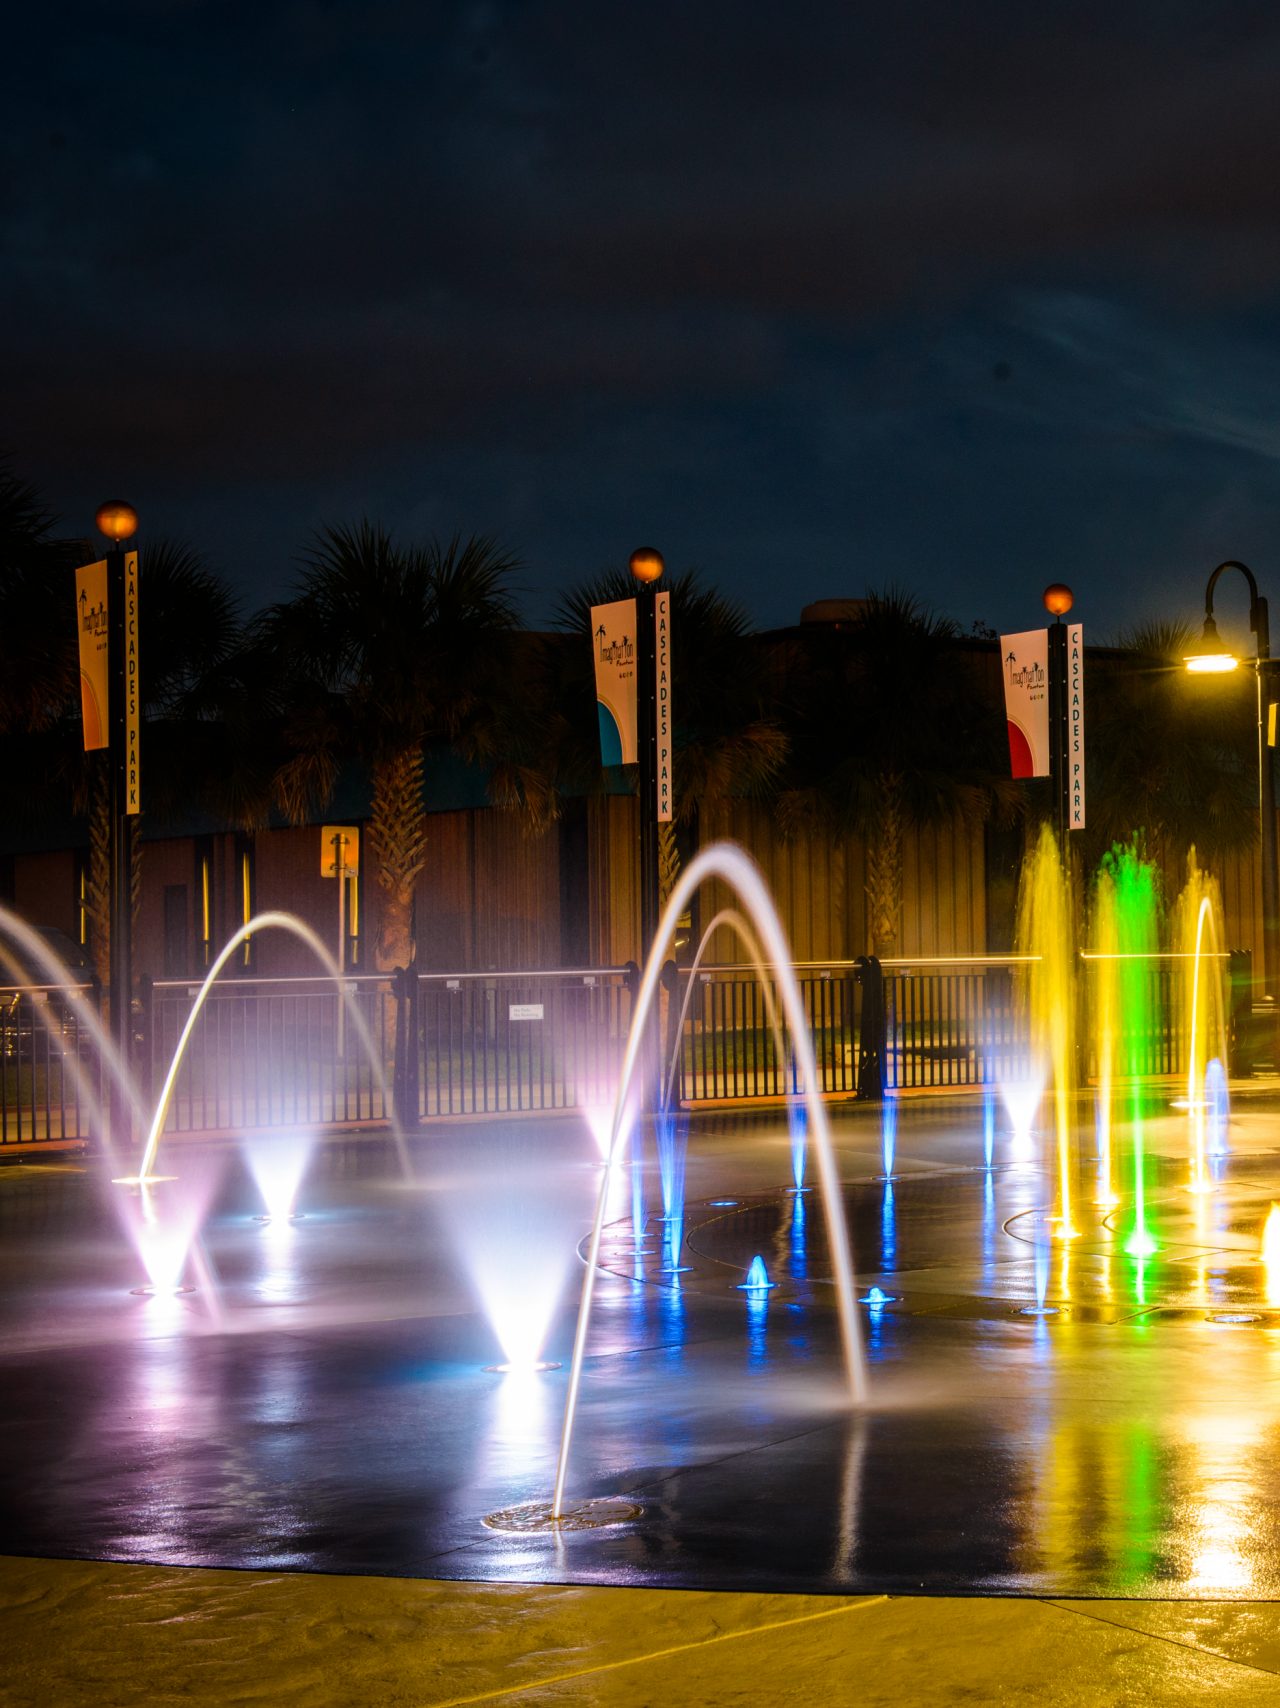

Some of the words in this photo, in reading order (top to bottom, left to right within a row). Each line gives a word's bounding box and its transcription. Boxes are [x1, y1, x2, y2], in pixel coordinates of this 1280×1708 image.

[659, 601, 667, 735] CASCADES
[1072, 632, 1080, 752] CASCADES
[1073, 764, 1081, 821] PARK
